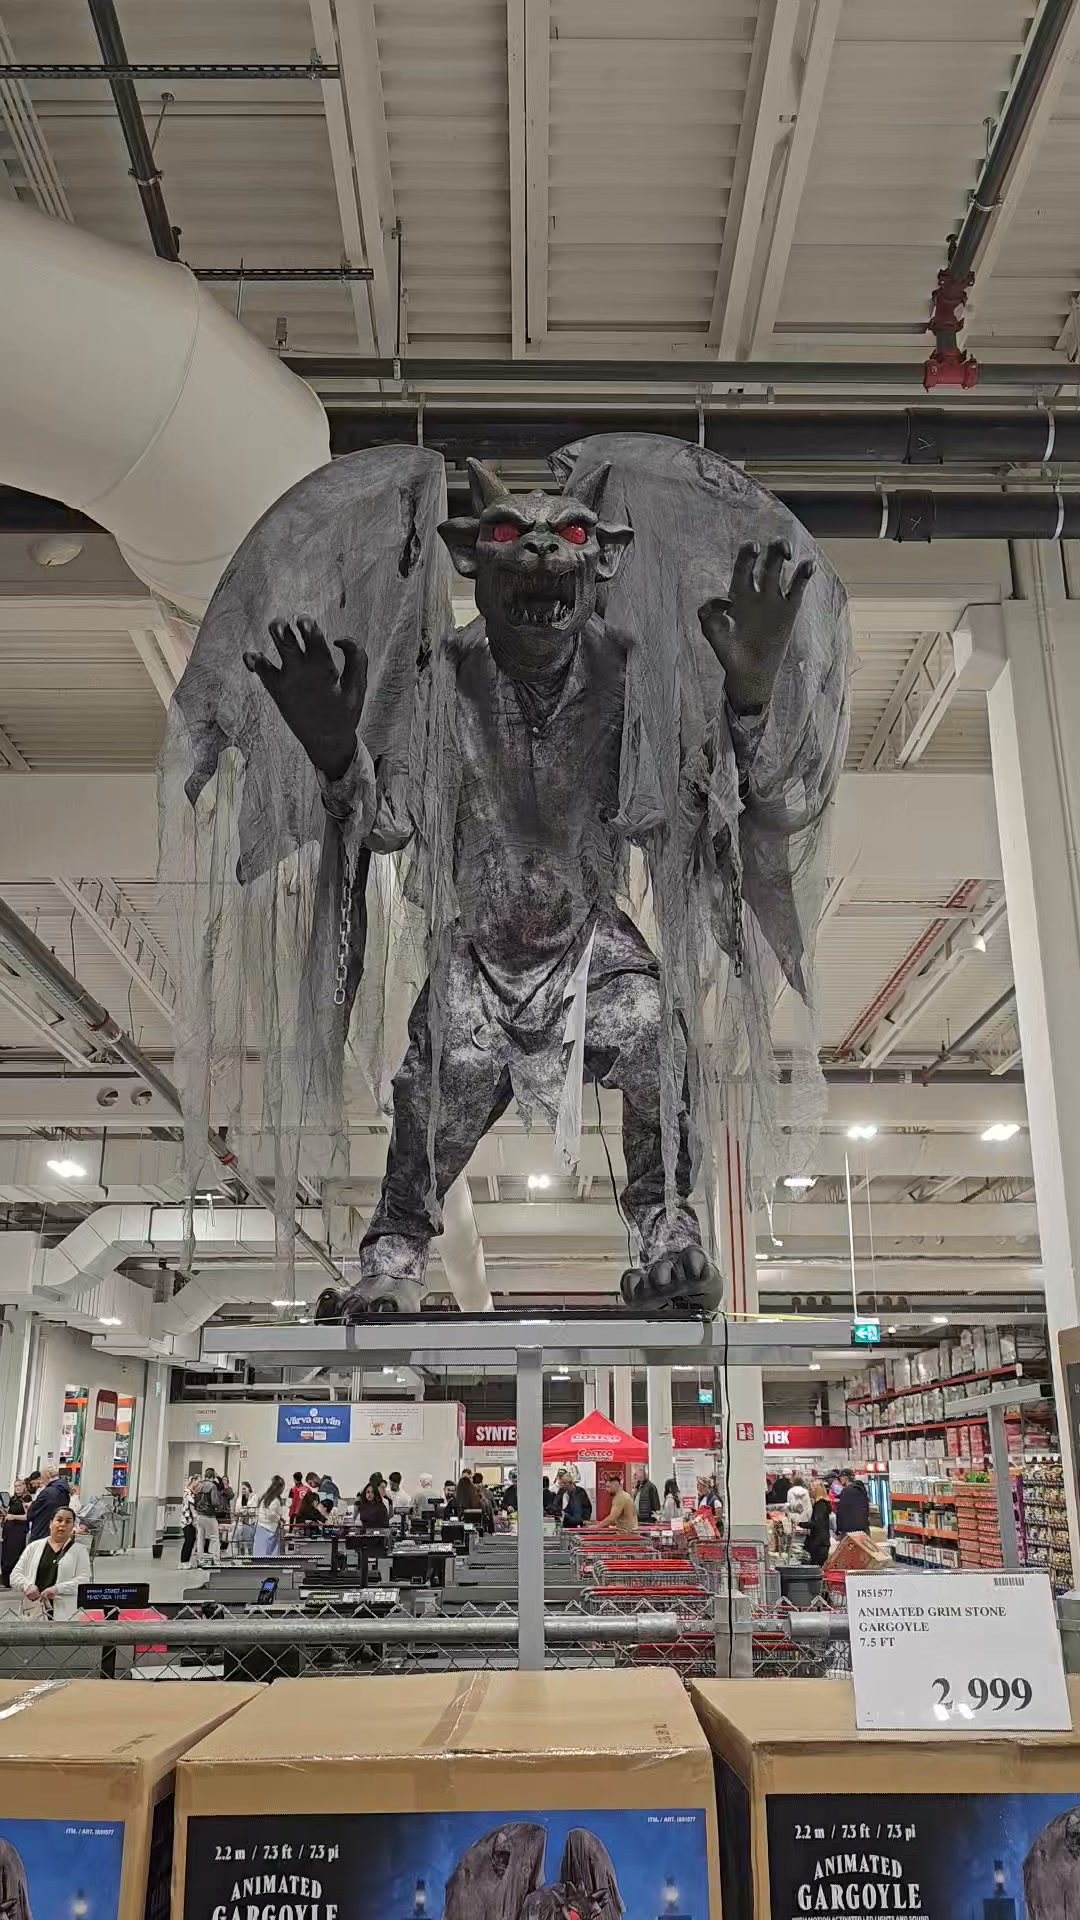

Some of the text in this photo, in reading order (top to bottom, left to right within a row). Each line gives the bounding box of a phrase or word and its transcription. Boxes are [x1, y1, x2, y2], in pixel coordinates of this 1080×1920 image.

[285, 1416, 341, 1426] Värva en vän
[856, 1589, 894, 1598] 1851577
[858, 1606, 1007, 1617] ANIMATED GRIM STONE
[859, 1622, 930, 1632] GARGOYLE
[859, 1637, 896, 1647] 7.5 FT
[794, 1823, 916, 1841] 2.2 m / 7.3 ft / 7.3 pi
[214, 1843, 340, 1862] 2.2 m / 7.3 ft / 7.3 pi
[814, 1853, 903, 1881] ANIMATED
[230, 1874, 323, 1902] ANIMATED
[797, 1883, 922, 1911] GARGOYLE
